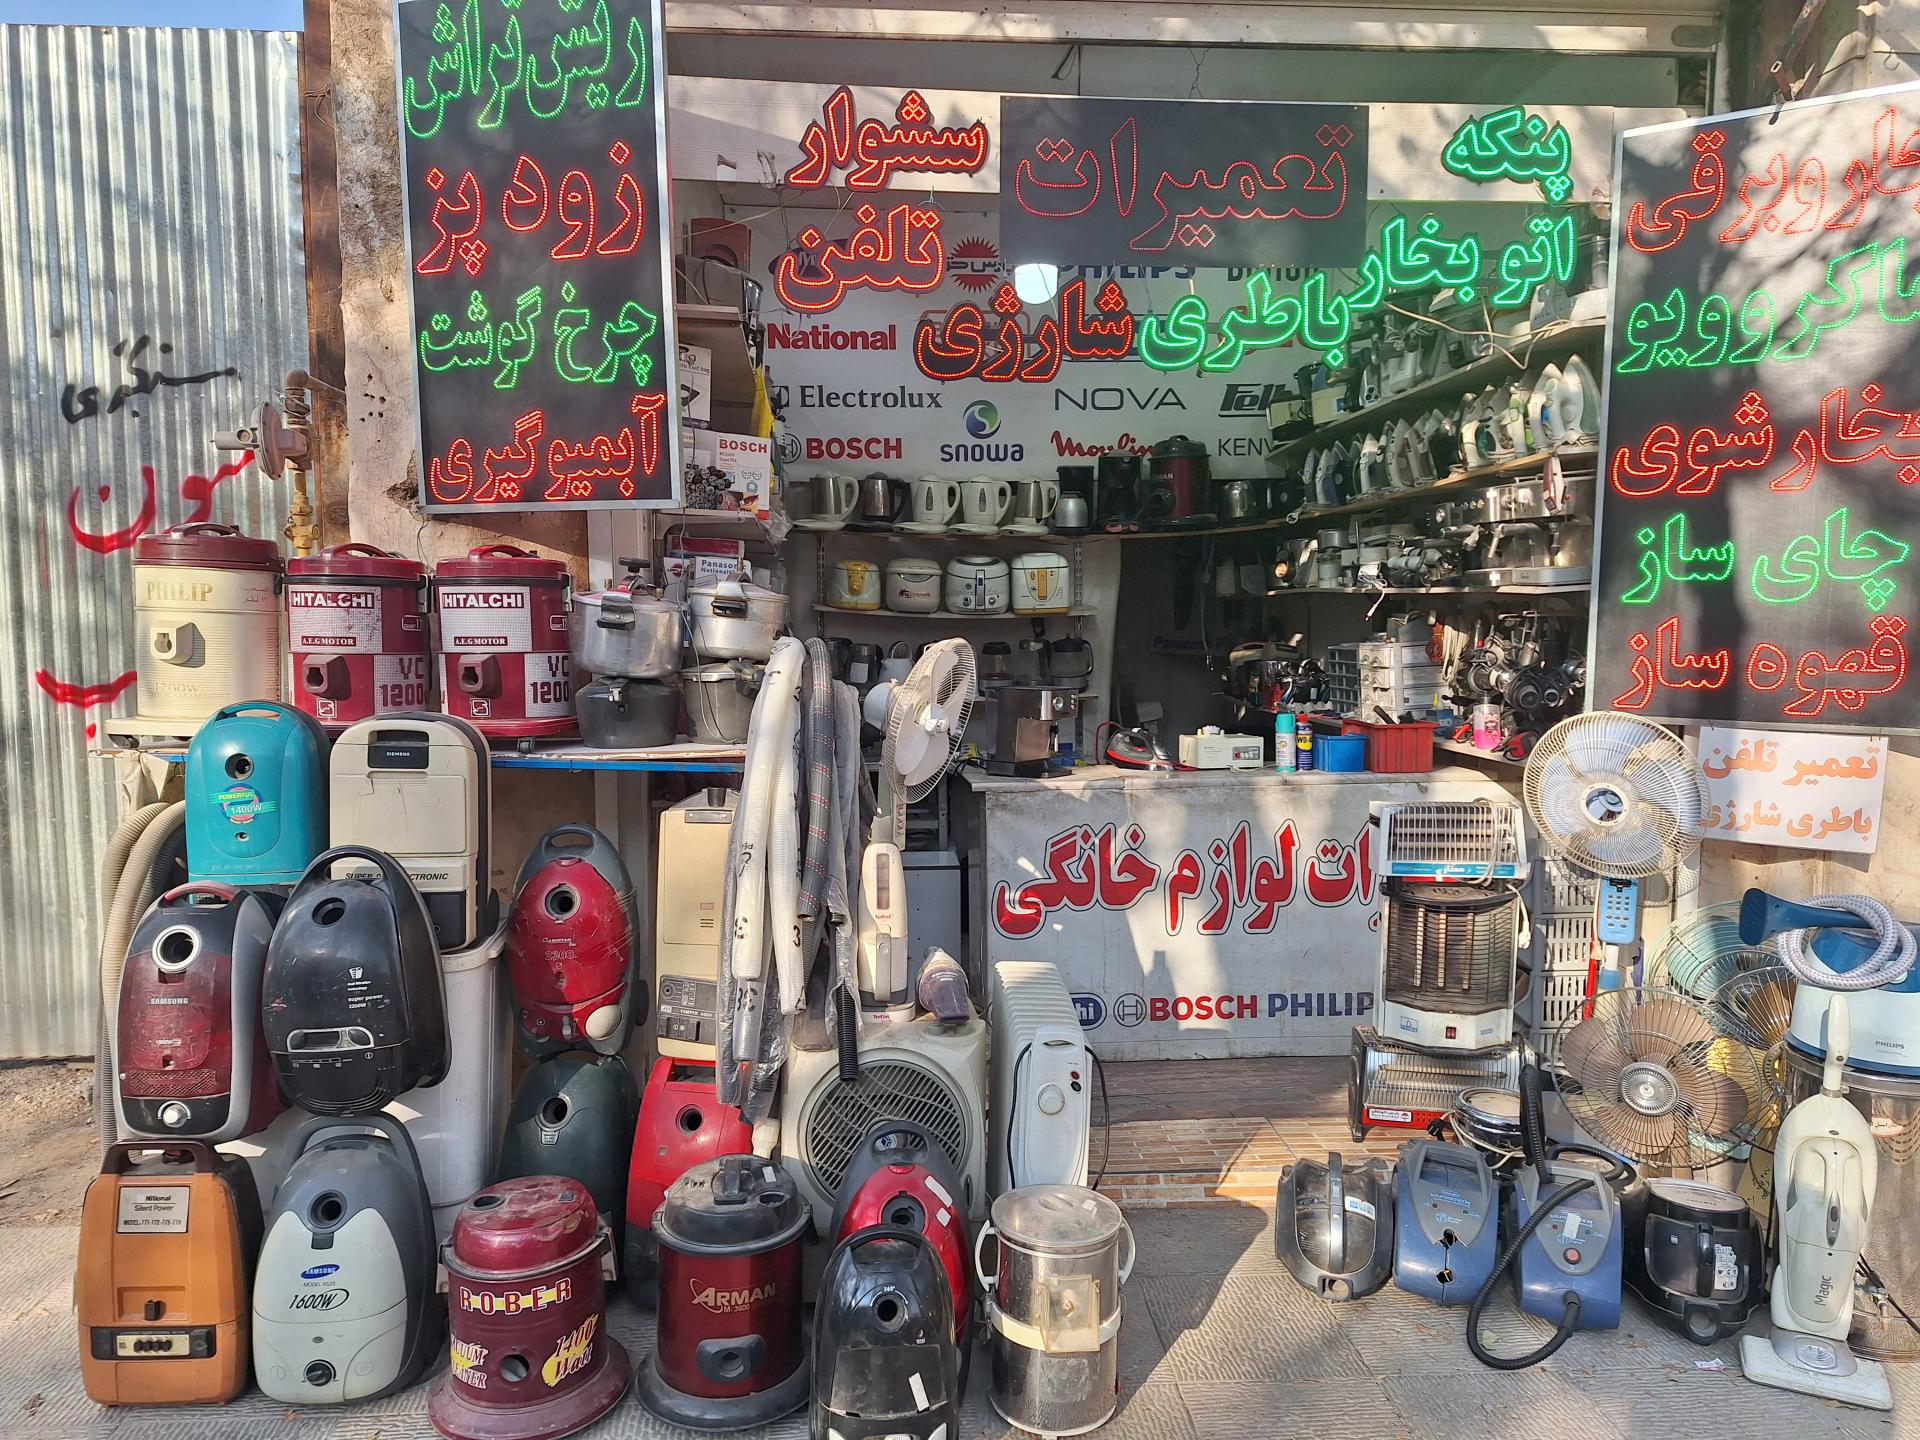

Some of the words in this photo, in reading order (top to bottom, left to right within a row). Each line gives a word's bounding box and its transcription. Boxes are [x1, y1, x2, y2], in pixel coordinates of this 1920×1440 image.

[784, 84, 988, 190] سشوار
[1443, 106, 1573, 204] پنکه
[500, 140, 645, 261] زود
[1014, 116, 1353, 252] تعمیرات
[415, 167, 488, 277] پز
[776, 203, 945, 312] تلفن
[1348, 213, 1480, 308] بخار
[1493, 213, 1577, 306] اتو
[419, 285, 542, 389] گوشت
[553, 281, 658, 388] چرخ
[768, 323, 896, 351] National
[915, 278, 1134, 383] شارژی
[1139, 269, 1350, 373] باطری
[799, 384, 943, 409] Electrolux
[1054, 387, 1187, 411] NOVA
[719, 438, 768, 454] BOSCH
[806, 437, 903, 461] BOSCH
[940, 442, 1024, 462] snowa
[1051, 430, 1154, 458] Moulin
[1620, 511, 1735, 604] ساز
[1751, 506, 1910, 612] چای
[290, 591, 373, 608] HITALCHI
[442, 592, 523, 608] HITALCHI
[473, 637, 507, 646] MOTOR
[399, 657, 424, 680] VC
[547, 655, 569, 676] VC
[1610, 616, 1730, 710] ساز
[1746, 615, 1908, 716] قهوه
[380, 683, 424, 707] 1200
[529, 681, 570, 704] 1200
[1702, 738, 1781, 779] تلفن
[1781, 745, 1882, 786] تعمیر
[230, 803, 263, 814] 1400W
[1786, 806, 1873, 842] باطری
[408, 872, 449, 881] CTRONIC
[993, 822, 1161, 940] خانگی
[1166, 820, 1301, 936] لوازم
[150, 997, 189, 1005] SAMSUNG
[1149, 995, 1258, 1021] BOSCH
[1267, 992, 1374, 1018] PHILIP
[1875, 1040, 1905, 1050] PHILIPS
[289, 1293, 338, 1309] 1600W
[458, 1276, 573, 1317] ROBER
[691, 1282, 776, 1306] ARMAN
[1813, 1274, 1834, 1307] Magic
